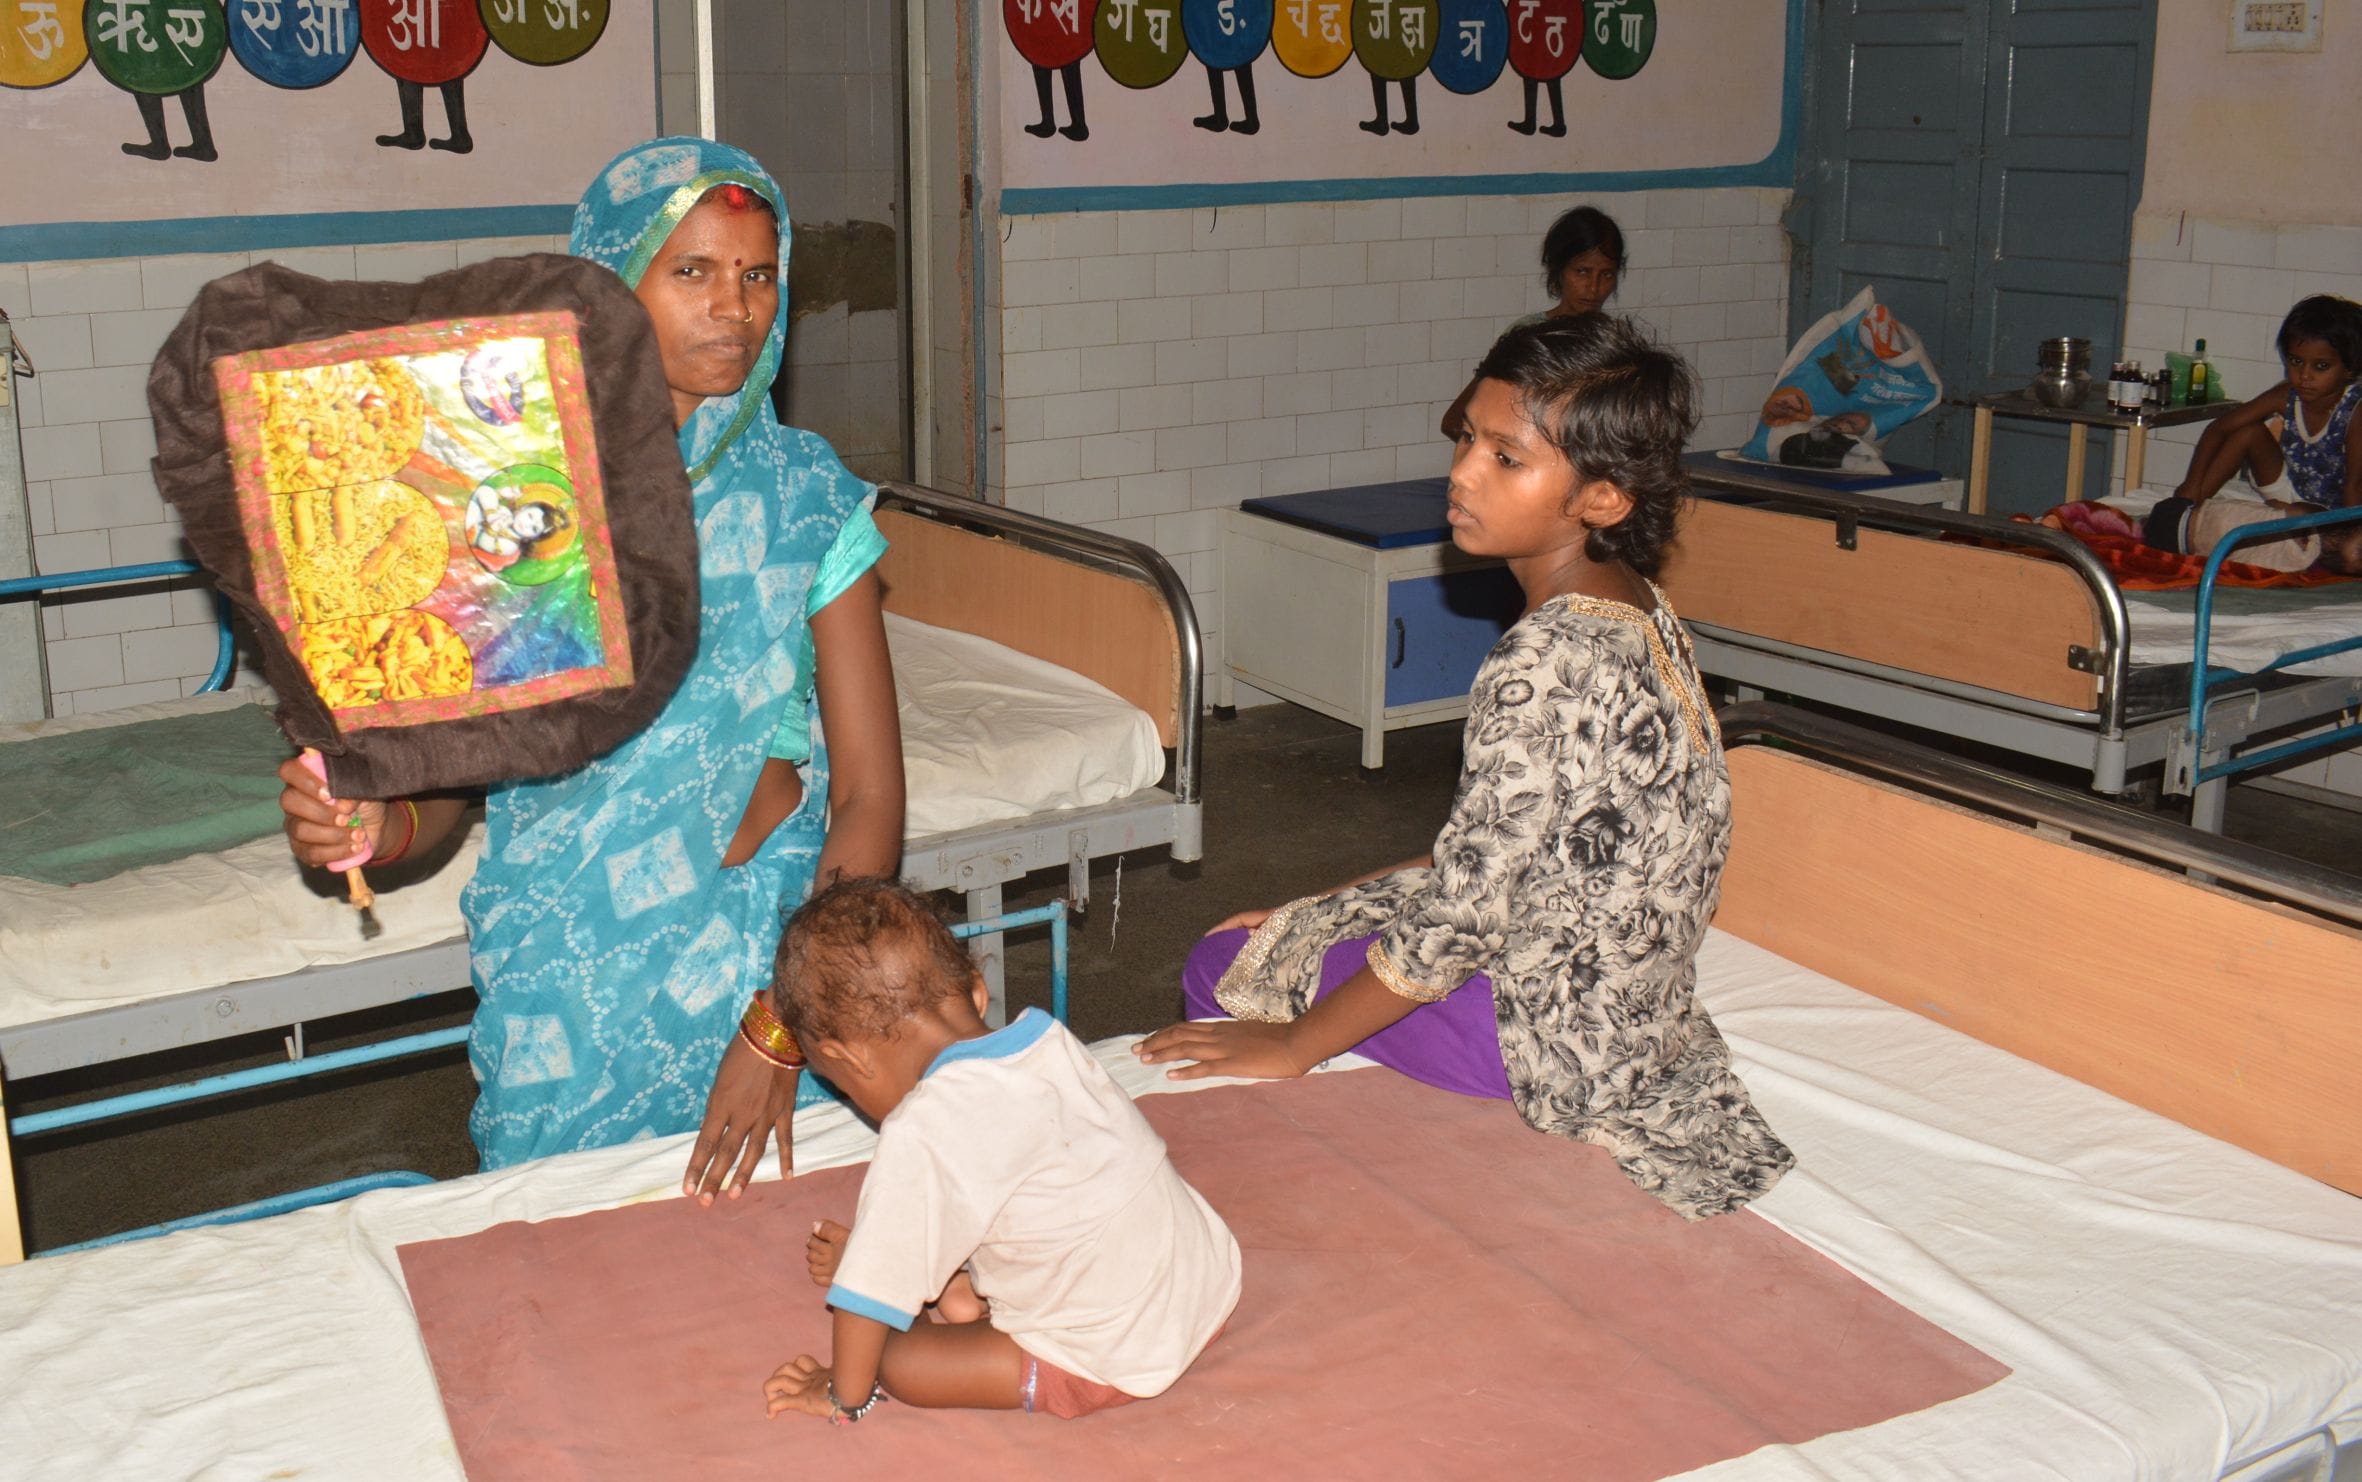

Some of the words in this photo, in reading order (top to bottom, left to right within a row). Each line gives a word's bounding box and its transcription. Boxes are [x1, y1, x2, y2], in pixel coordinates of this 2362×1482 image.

[16, 2, 65, 61] ऊ
[97, 0, 159, 53] ऋ
[1107, 0, 1138, 43] ग
[1144, 9, 1172, 53] घ
[1368, 0, 1393, 40] ज
[1545, 16, 1567, 58] ठ
[1619, 13, 1644, 54] ण
